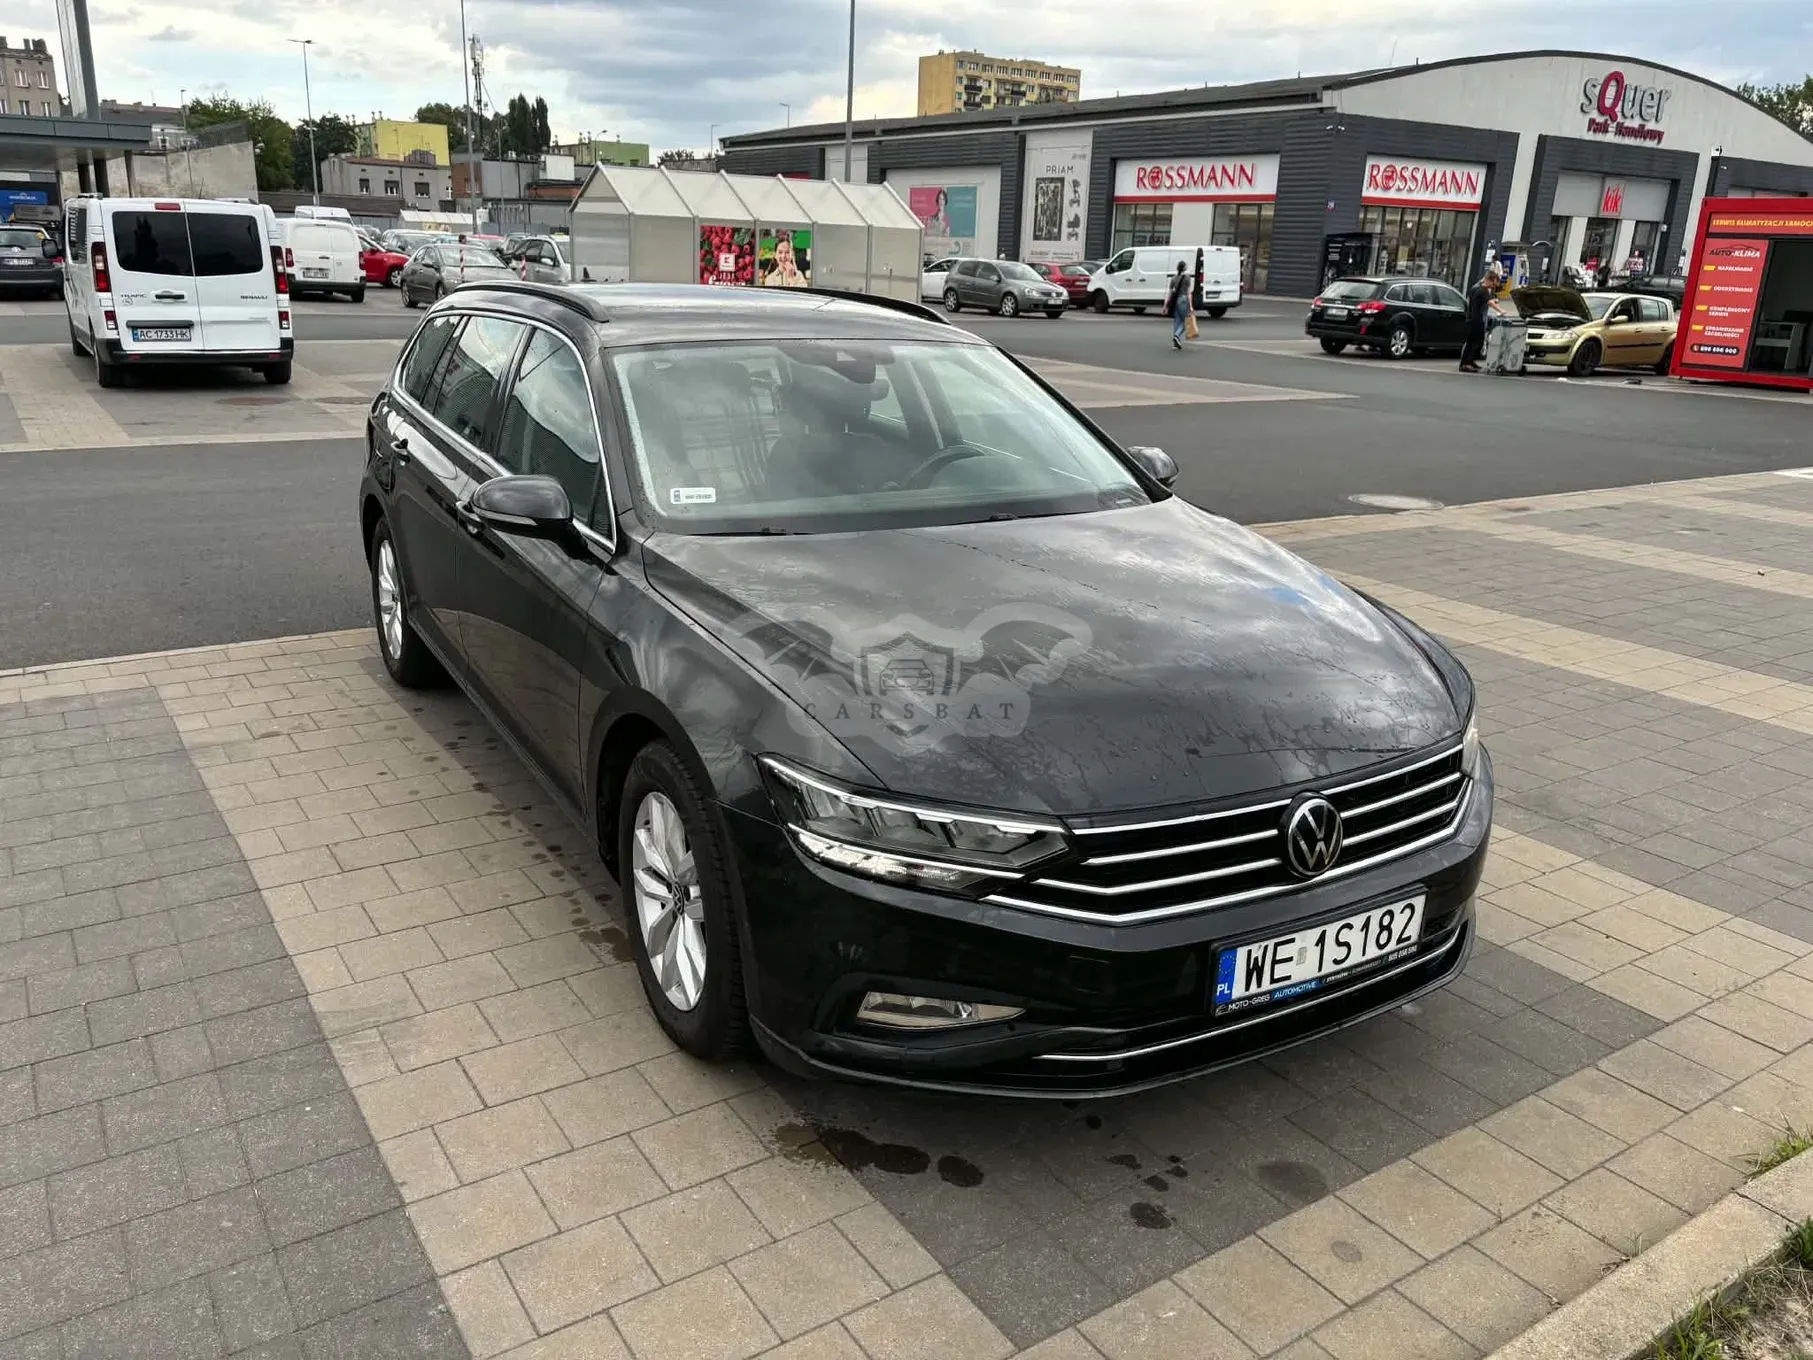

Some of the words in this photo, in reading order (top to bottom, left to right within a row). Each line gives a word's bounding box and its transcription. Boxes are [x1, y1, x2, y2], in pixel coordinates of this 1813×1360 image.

[1587, 118, 1609, 134] Park
[1614, 121, 1665, 145] Handlowy
[1045, 165, 1074, 175] PRIAM
[1136, 162, 1257, 191] ROSSMANN
[1366, 163, 1481, 196] ROSSMANN
[139, 329, 153, 340] AC
[154, 329, 175, 340] 1733
[1244, 937, 1297, 993] WE
[1315, 902, 1416, 973] 1S182
[1216, 982, 1231, 996] PL
[1273, 980, 1318, 999] AUTOMOTIVE
